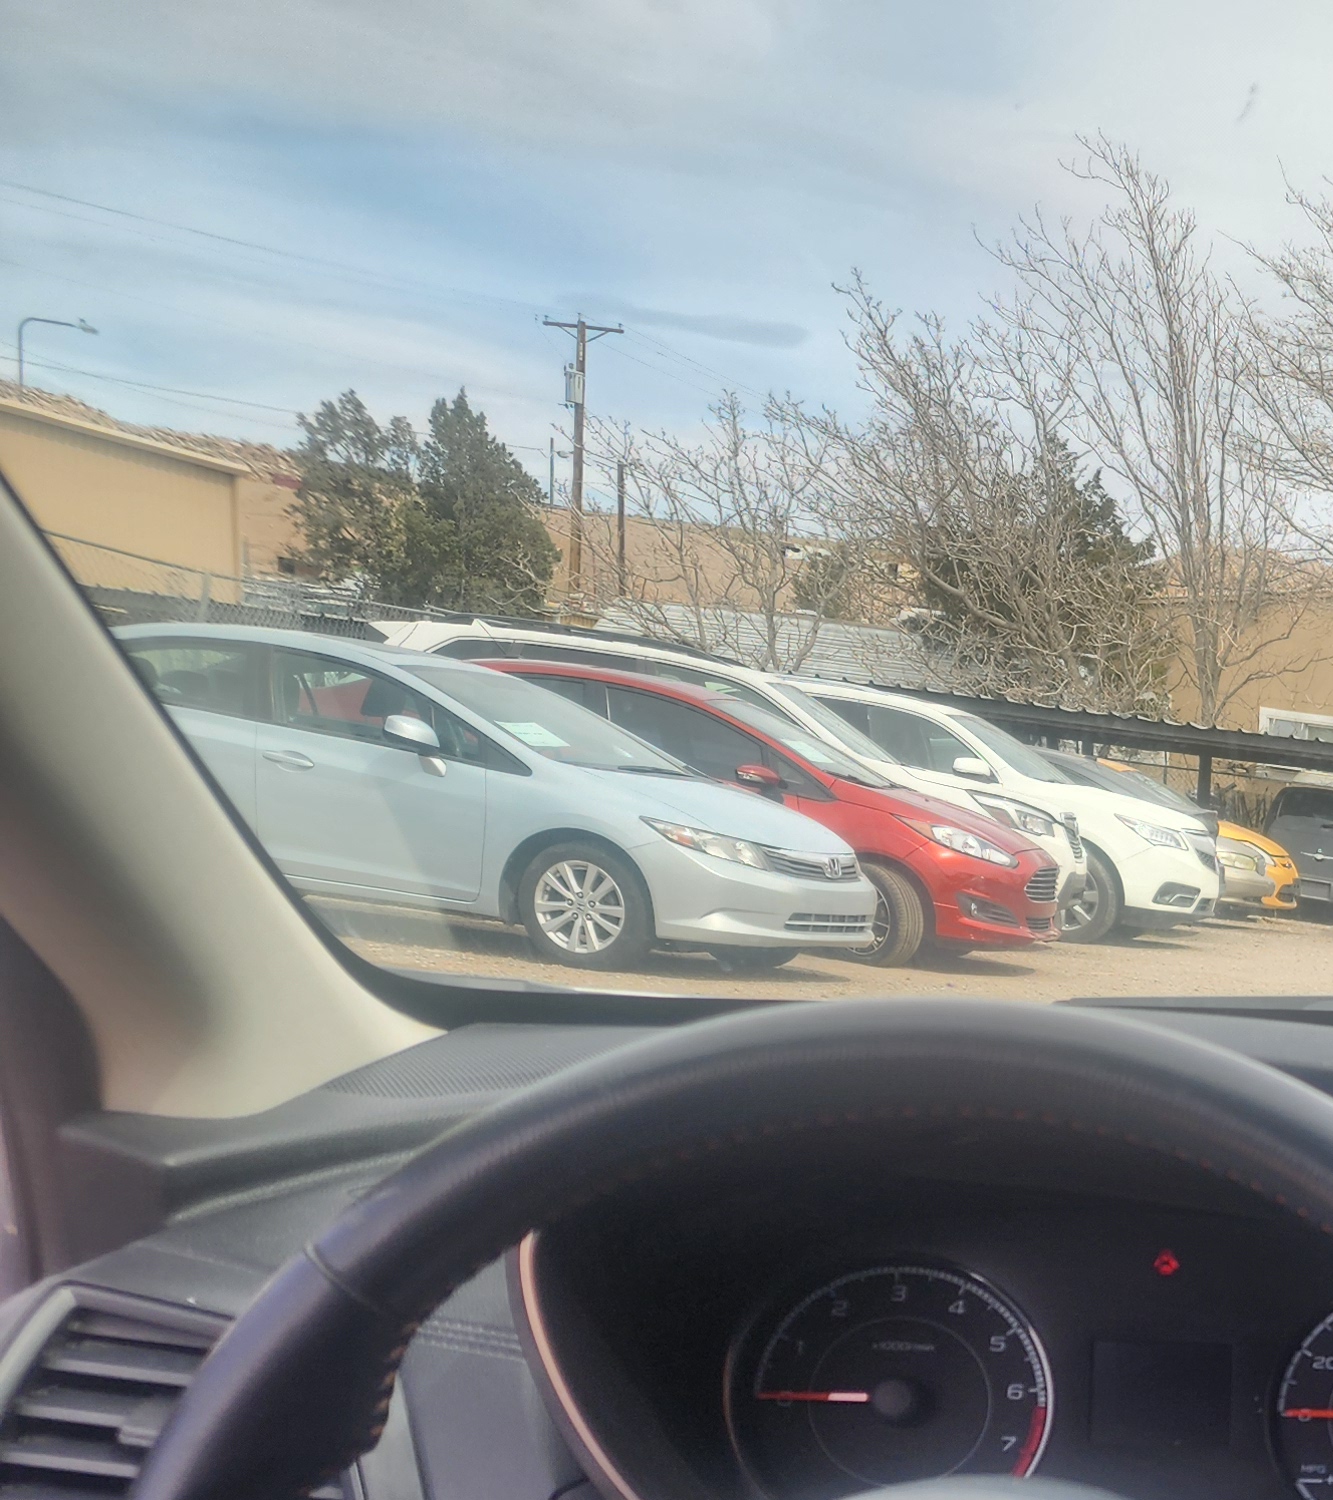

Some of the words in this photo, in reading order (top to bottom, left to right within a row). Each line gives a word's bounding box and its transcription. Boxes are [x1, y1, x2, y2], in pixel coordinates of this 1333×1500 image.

[891, 1285, 907, 1302] 3
[832, 1301, 849, 1316] 2
[949, 1300, 965, 1315] 4
[990, 1336, 1006, 1352] 5
[1007, 1384, 1022, 1400] 6
[1001, 1436, 1017, 1451] 7
